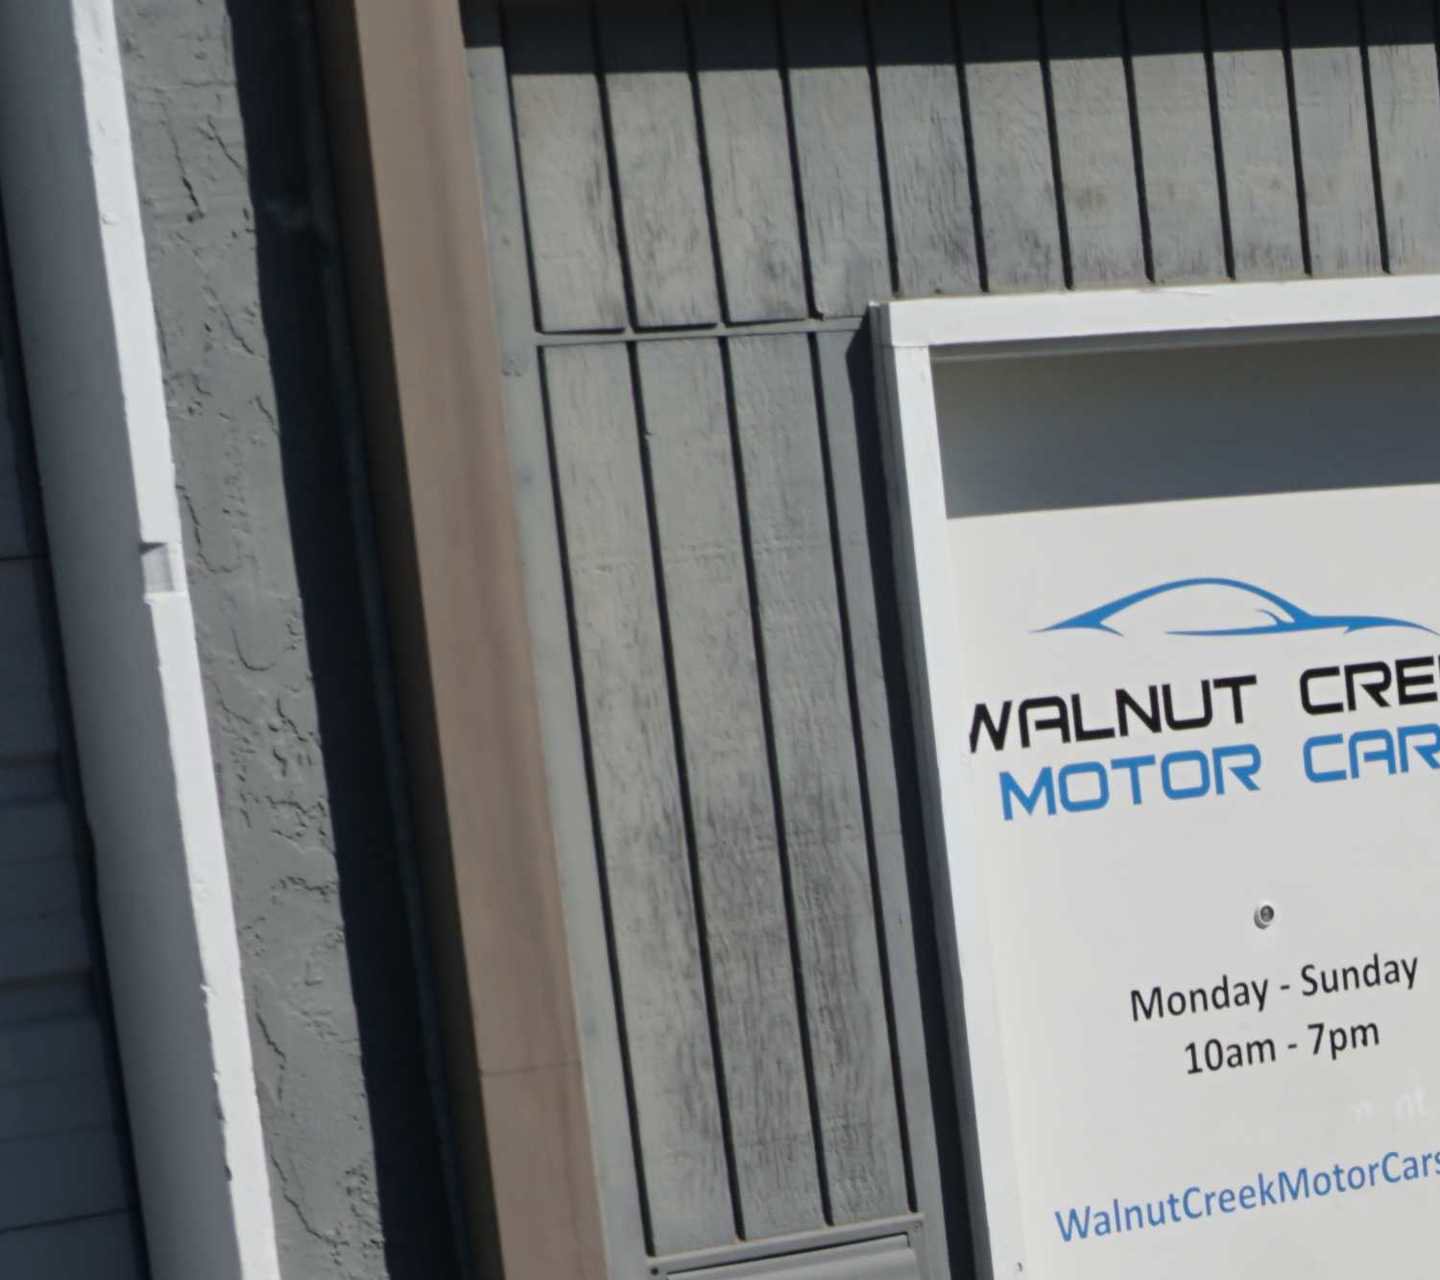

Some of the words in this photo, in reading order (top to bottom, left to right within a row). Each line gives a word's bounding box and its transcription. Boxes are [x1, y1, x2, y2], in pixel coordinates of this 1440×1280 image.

[969, 674, 1258, 753] WALNUT
[999, 742, 1263, 821] MOTOR
[1129, 974, 1270, 1022] Monday
[1300, 953, 1419, 998] Sunday
[1184, 1037, 1277, 1075] 10am
[1306, 1021, 1381, 1060] 7pm
